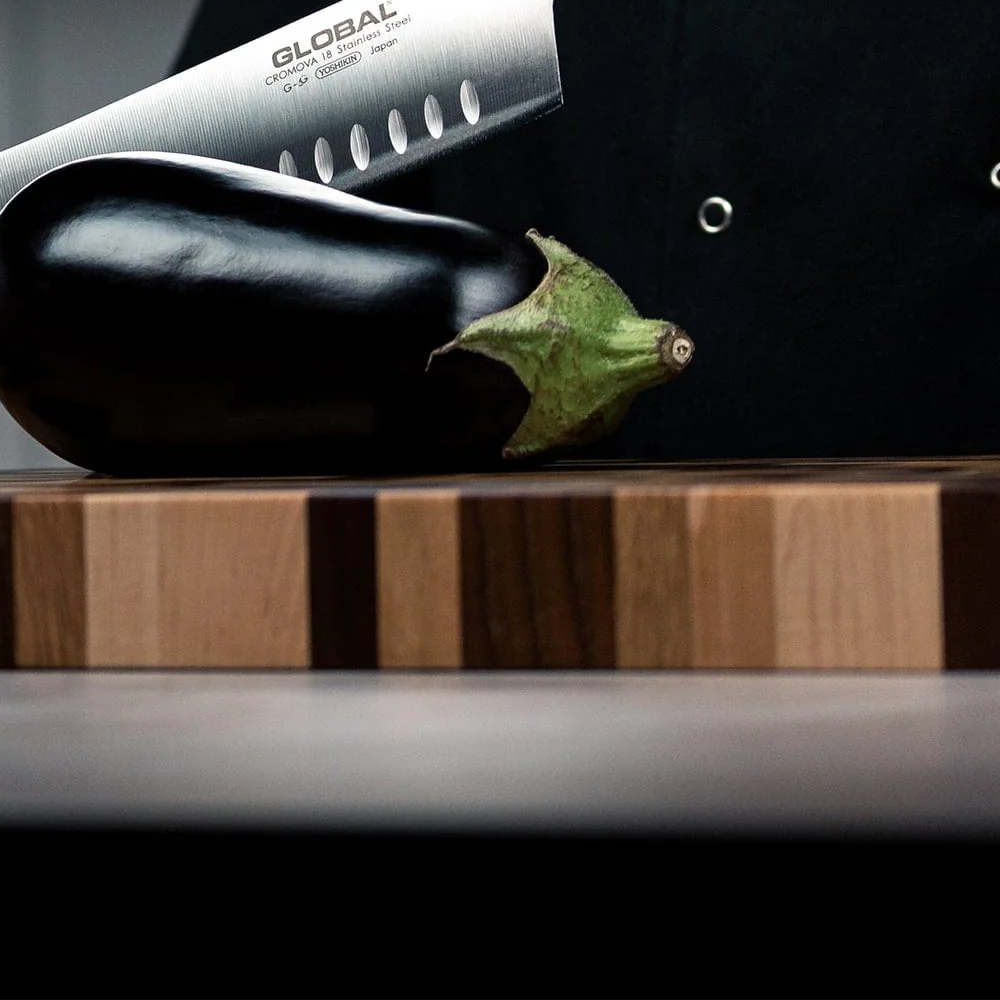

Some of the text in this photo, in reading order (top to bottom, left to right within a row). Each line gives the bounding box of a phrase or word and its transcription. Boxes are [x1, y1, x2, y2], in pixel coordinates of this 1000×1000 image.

[265, 14, 411, 86] CROMOVA 18 Stainless Steel
[271, 3, 397, 68] GLOBAL
[318, 53, 358, 77] YOSHIKIN
[370, 37, 398, 55] Japan
